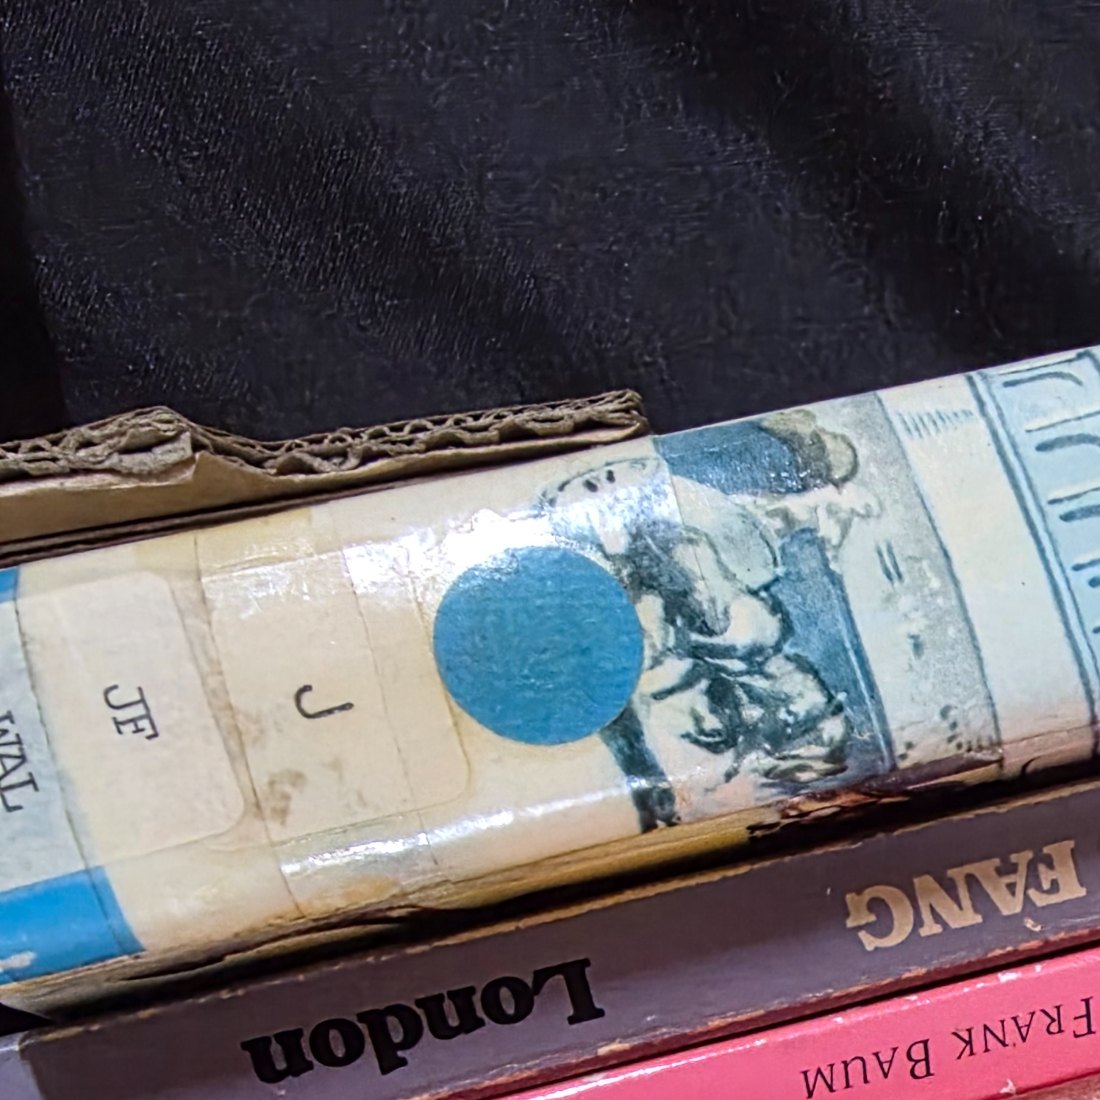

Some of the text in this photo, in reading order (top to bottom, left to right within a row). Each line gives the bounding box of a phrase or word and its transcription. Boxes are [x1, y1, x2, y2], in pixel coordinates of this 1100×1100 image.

[294, 685, 354, 719] J
[846, 840, 1087, 952] FANG
[241, 957, 606, 1085] London
[951, 998, 1098, 1061] FRANK
[800, 1039, 935, 1100] BAUM
